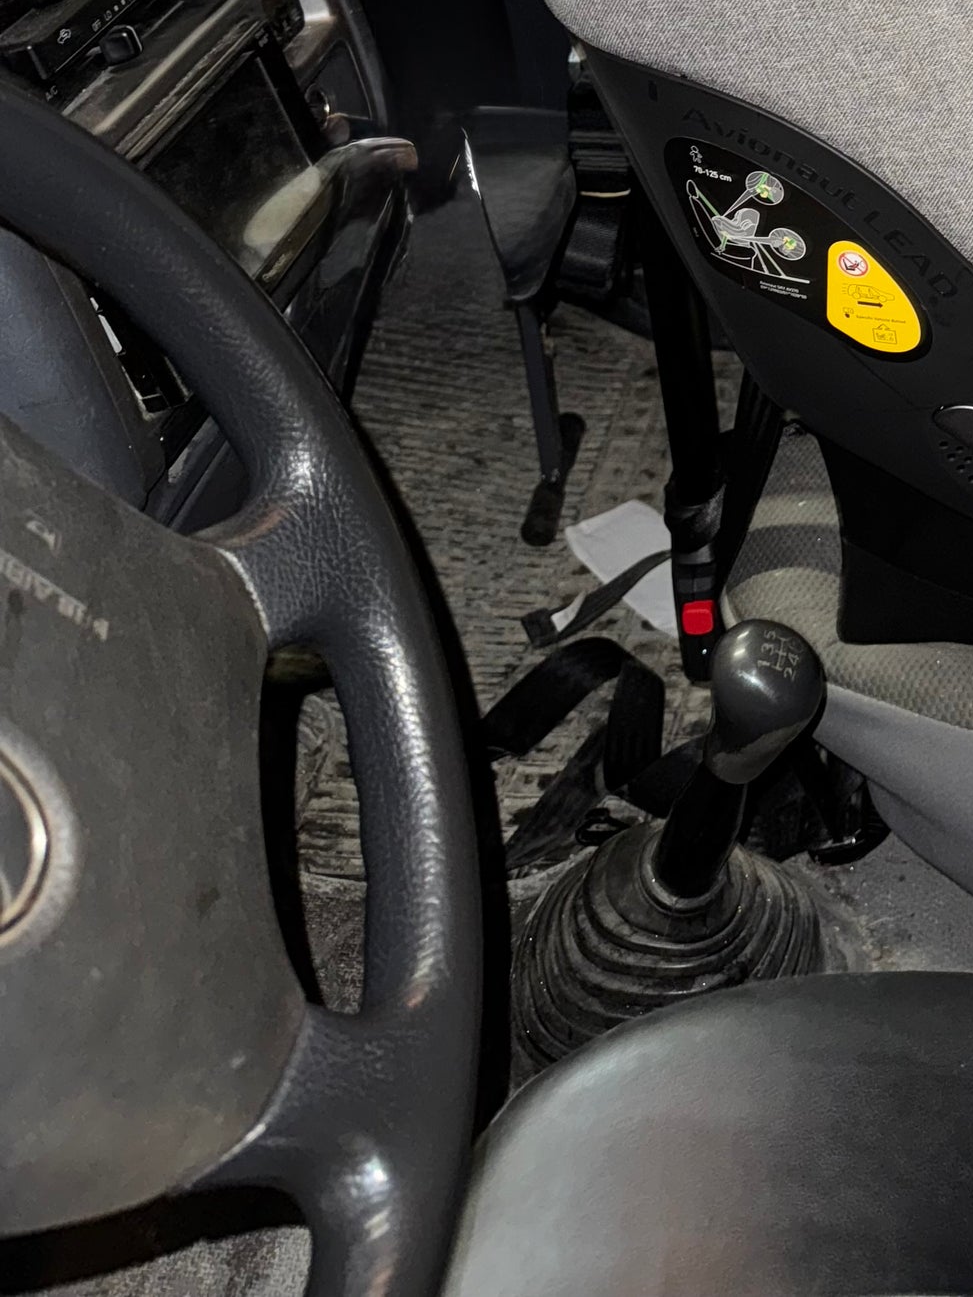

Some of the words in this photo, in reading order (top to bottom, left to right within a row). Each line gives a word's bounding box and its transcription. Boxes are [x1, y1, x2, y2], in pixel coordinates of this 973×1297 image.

[680, 106, 864, 212] Avionaut
[863, 209, 960, 300] LEAD
[693, 165, 719, 179] 70-125
[719, 174, 732, 182] cm
